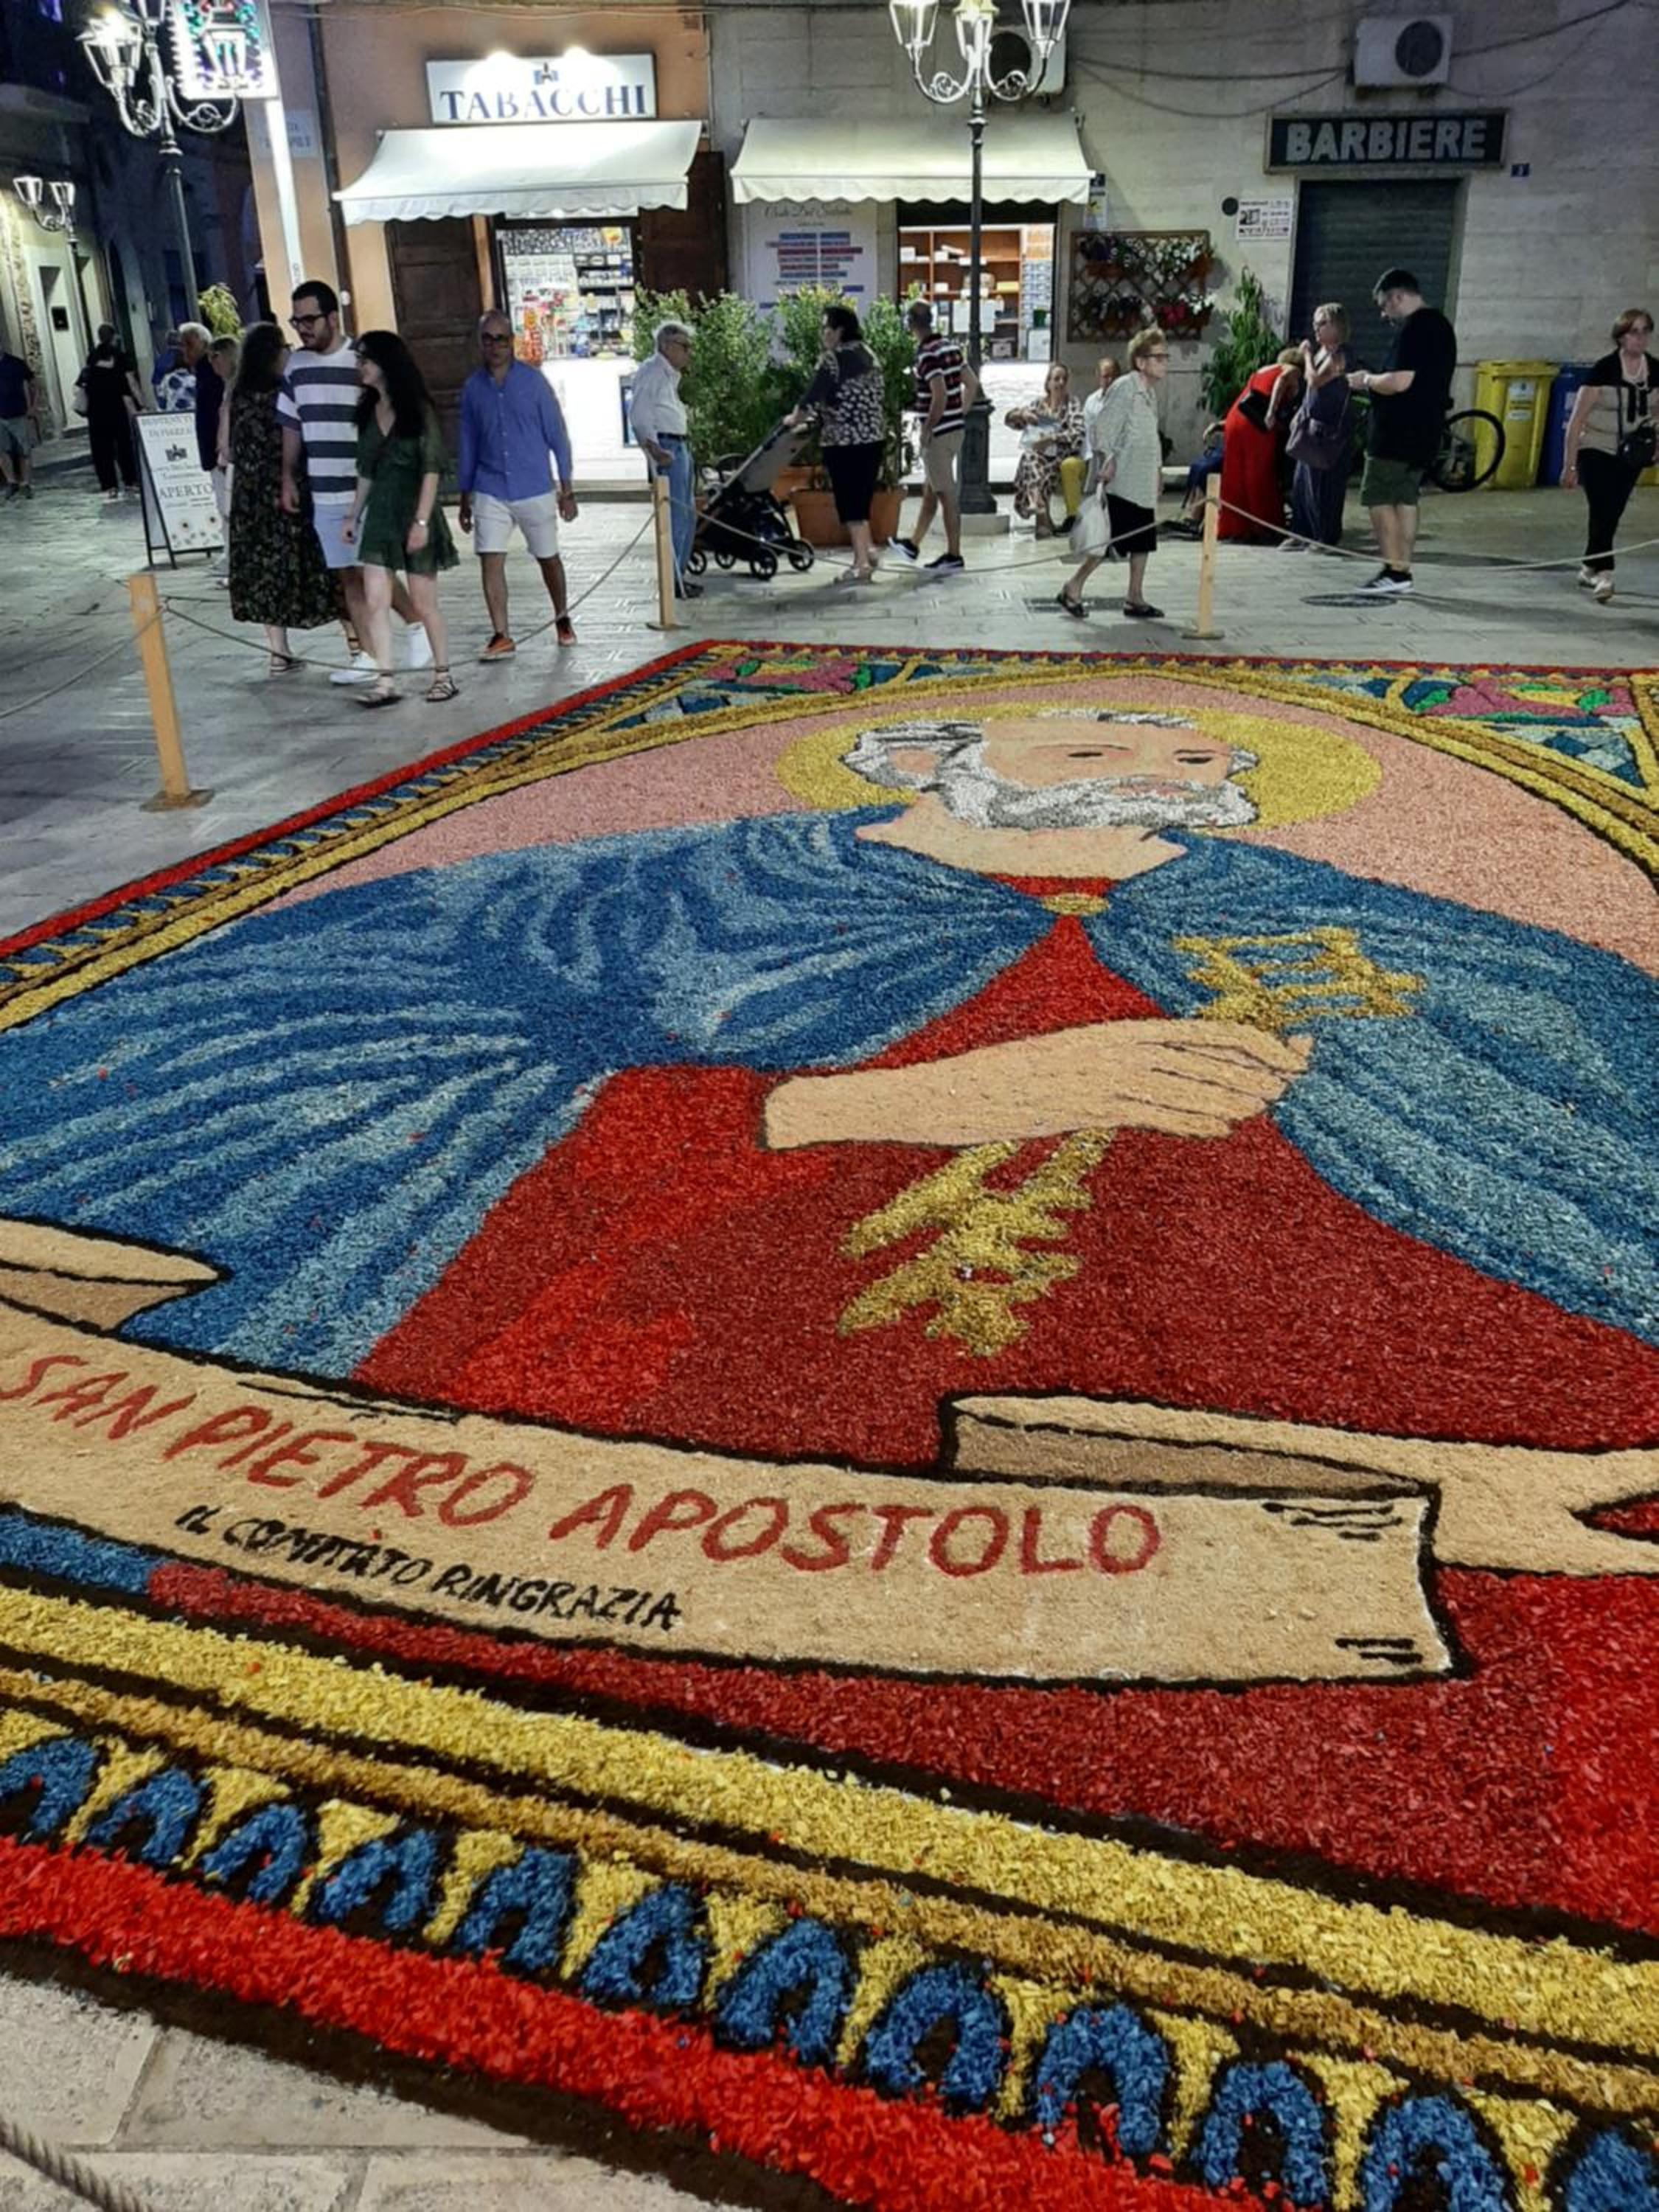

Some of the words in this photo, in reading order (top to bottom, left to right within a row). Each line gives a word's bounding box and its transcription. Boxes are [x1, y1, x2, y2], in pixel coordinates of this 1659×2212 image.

[439, 85, 647, 120] TABACCHI
[1286, 119, 1486, 161] BARBIERE
[159, 484, 213, 498] APERTO
[0, 1355, 196, 1440] SAN
[163, 1405, 535, 1527] PIETRO
[549, 1482, 1162, 1578] APOSTOLO
[431, 1563, 681, 1631] RINGRAZIA
